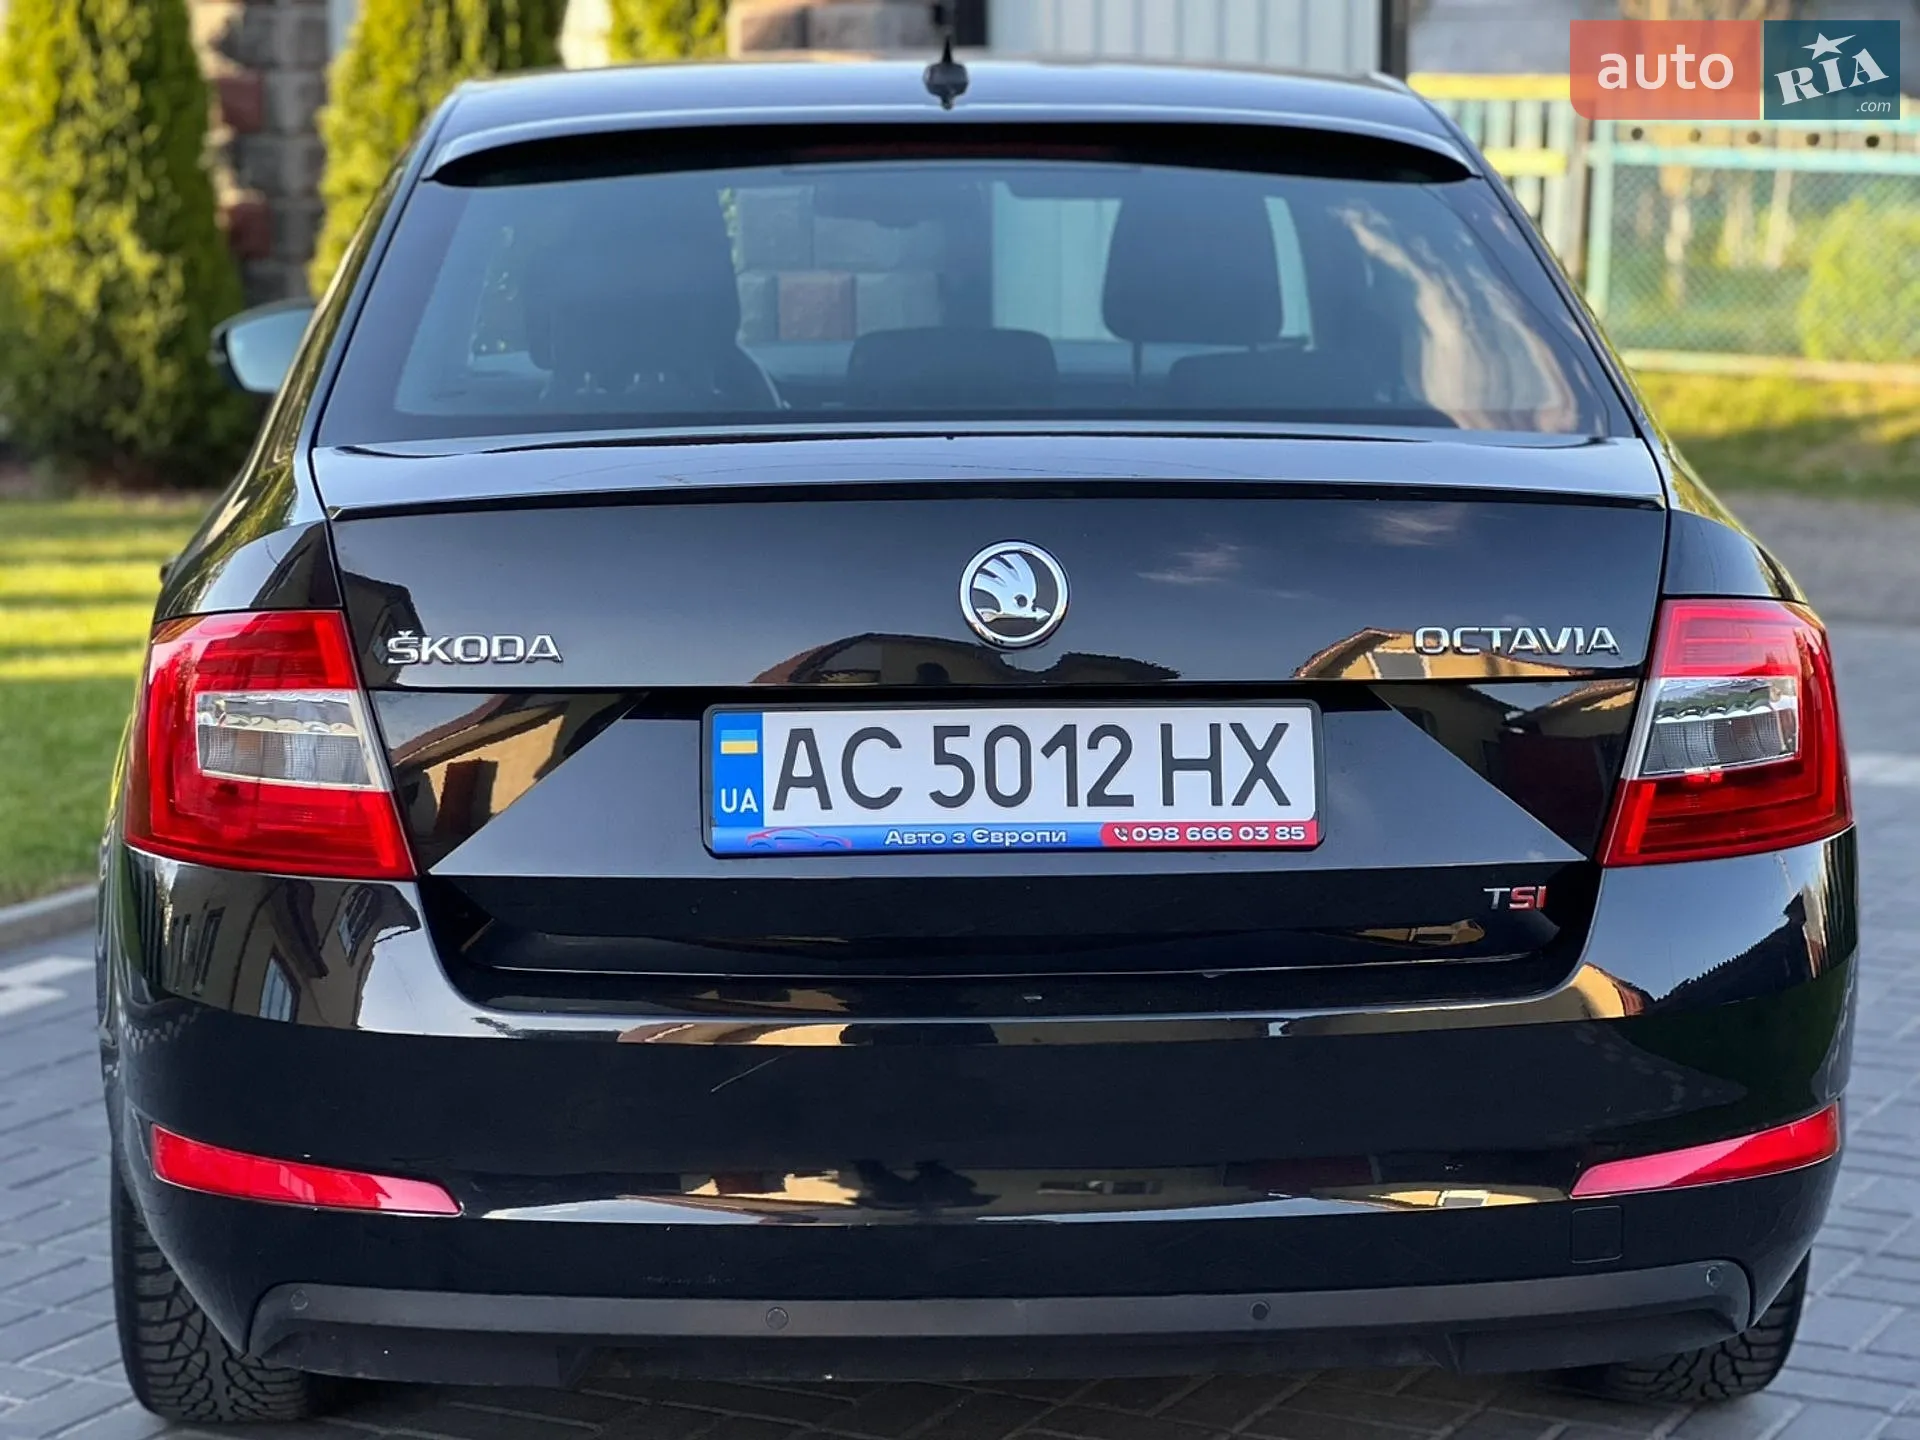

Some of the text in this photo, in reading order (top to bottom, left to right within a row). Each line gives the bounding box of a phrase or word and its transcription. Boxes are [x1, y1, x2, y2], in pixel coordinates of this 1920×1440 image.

[387, 630, 563, 664] ŠKODA
[1414, 626, 1621, 655] OCTAVIA
[772, 723, 1292, 811] AC 5012 HX
[720, 788, 758, 813] UA
[884, 828, 1067, 846] Авто з Європи
[1132, 826, 1305, 841] 098 666 03 85
[1483, 886, 1547, 910] TSI
